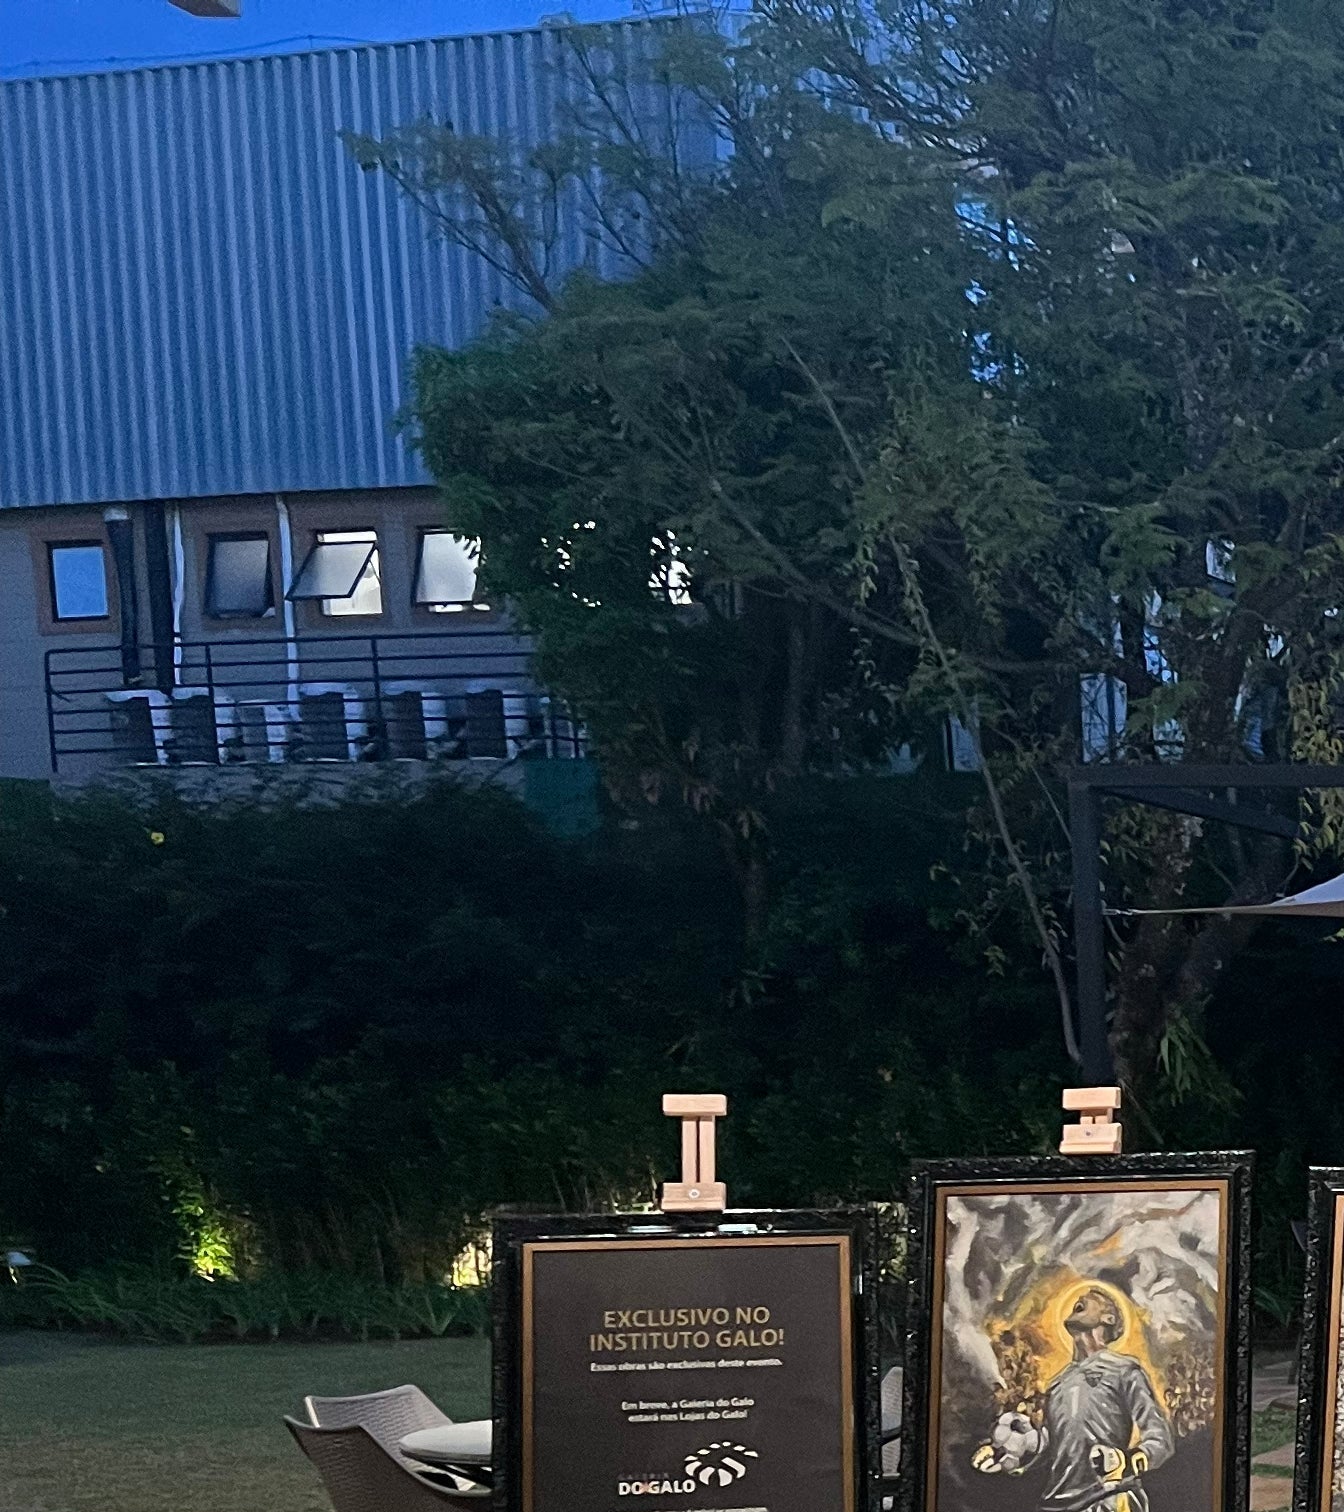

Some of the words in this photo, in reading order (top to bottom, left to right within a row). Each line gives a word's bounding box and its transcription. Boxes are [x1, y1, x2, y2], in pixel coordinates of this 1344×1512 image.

[604, 1308, 730, 1328] EXCLUSIVO
[735, 1307, 770, 1325] NO
[590, 1331, 710, 1351] INSTITUTO
[715, 1329, 784, 1348] GALO!
